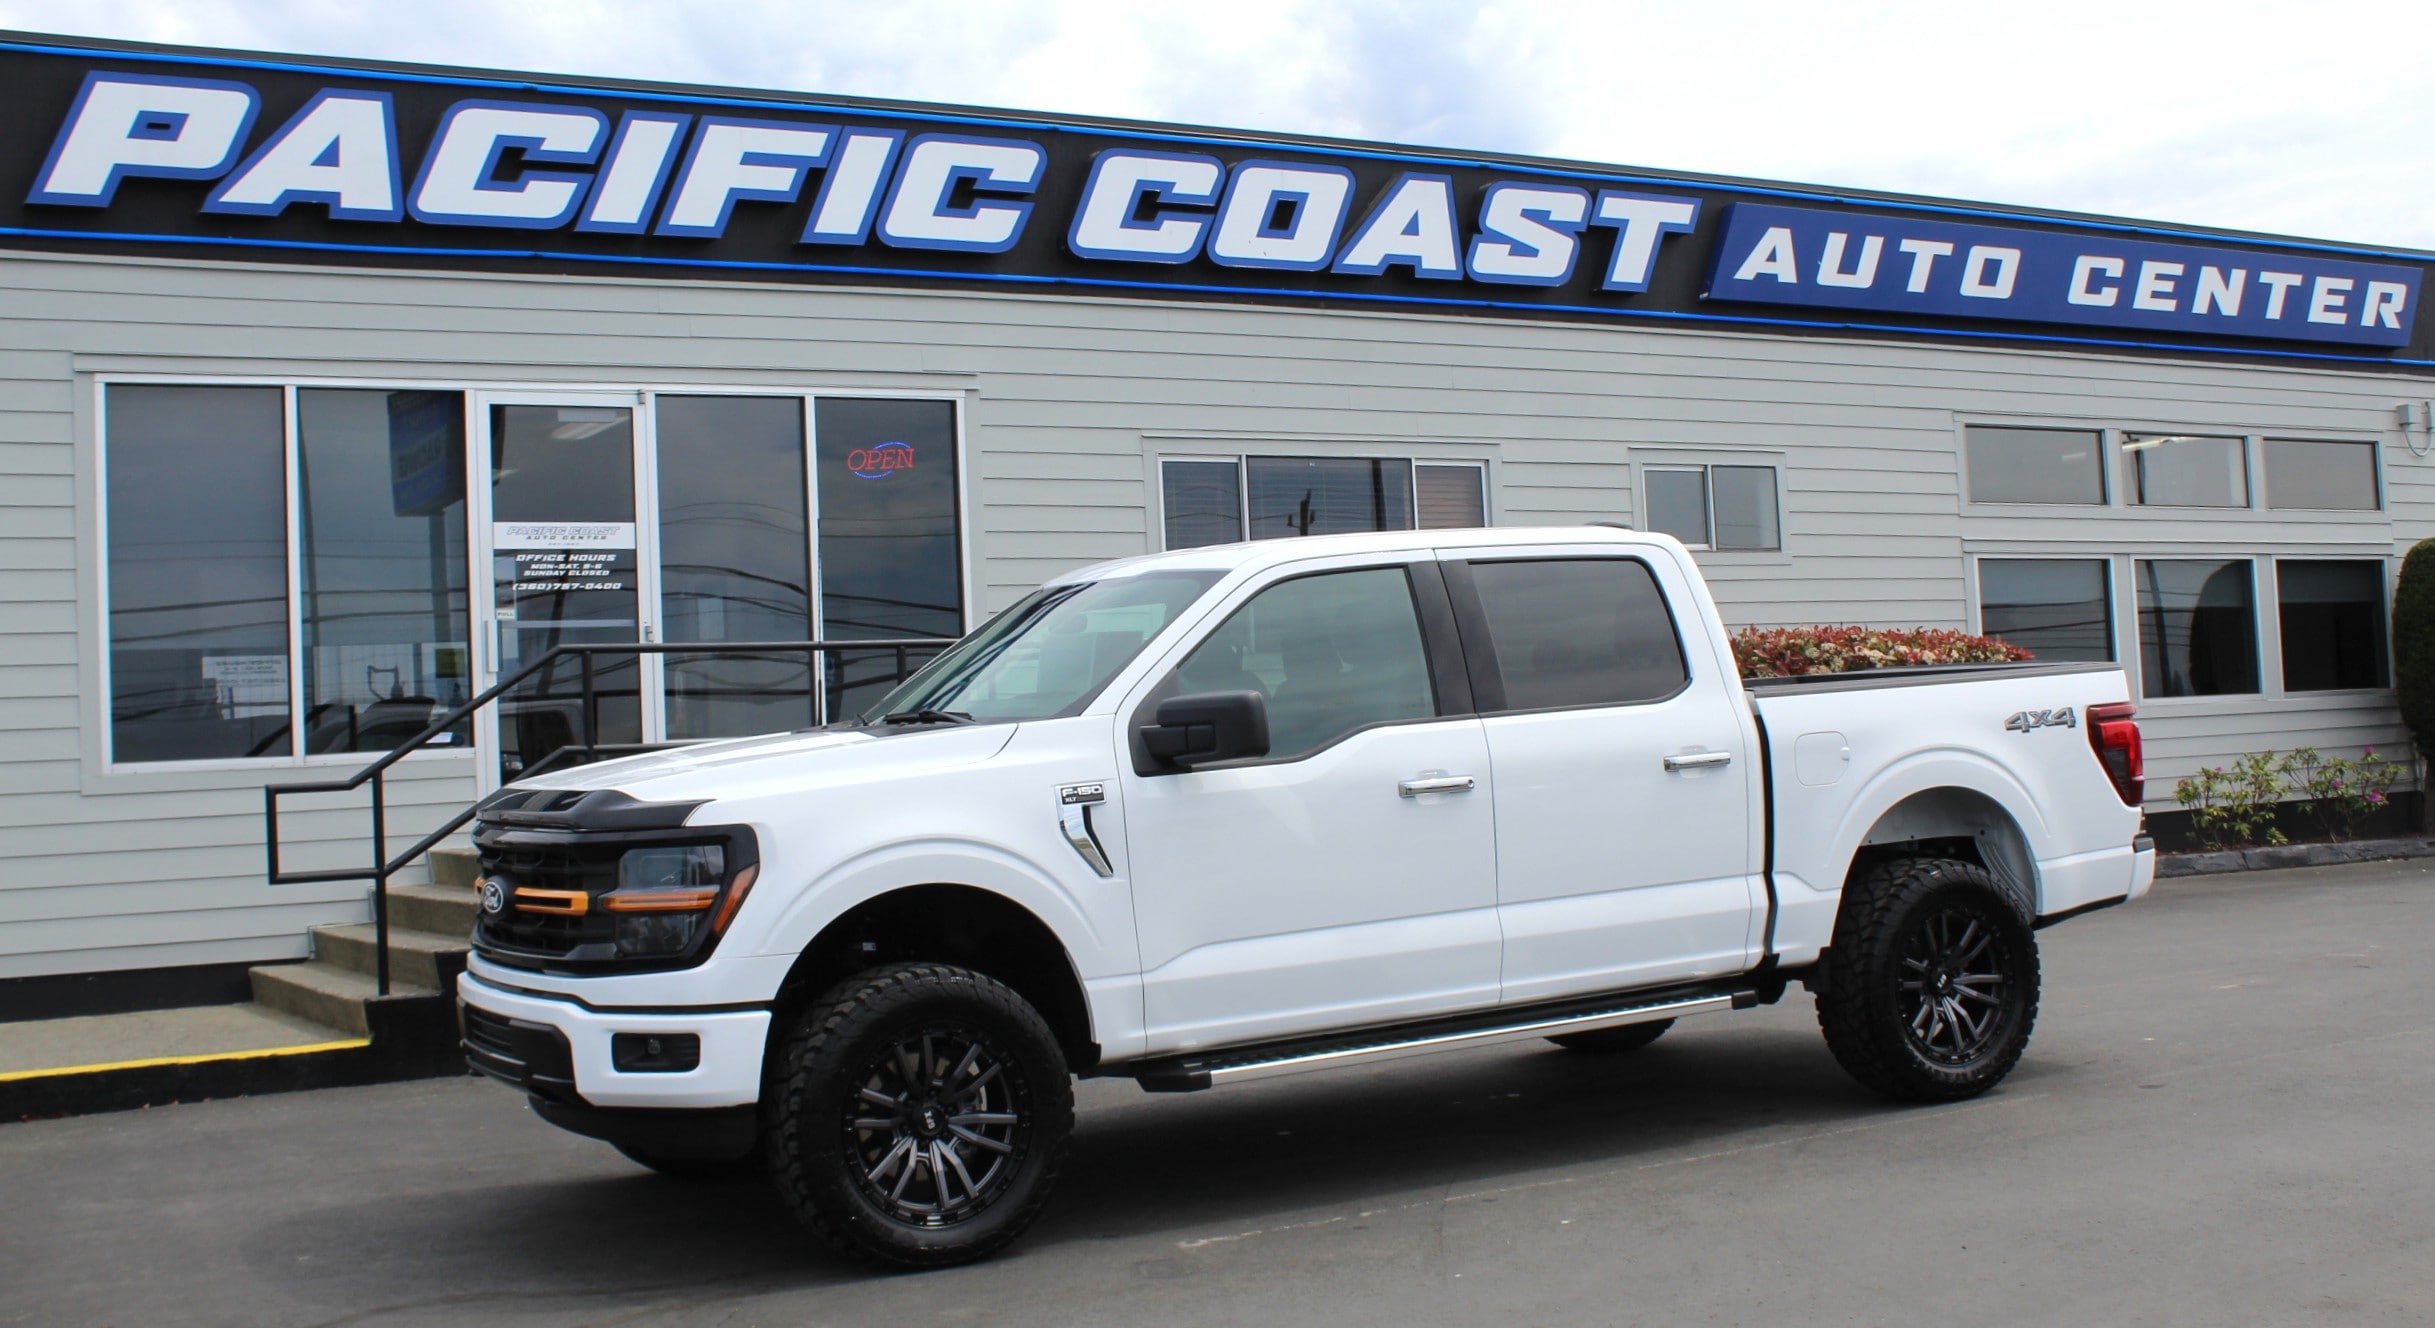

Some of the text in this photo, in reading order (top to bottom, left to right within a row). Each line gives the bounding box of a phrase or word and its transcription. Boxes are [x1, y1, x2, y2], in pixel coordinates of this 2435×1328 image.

[24, 70, 1702, 293] PACIFIC COAST
[1733, 226, 2408, 330] AUTO CENTER
[847, 447, 915, 471] OPEN
[507, 526, 620, 535] PACIFIC COAST
[1062, 785, 1103, 797] F-150
